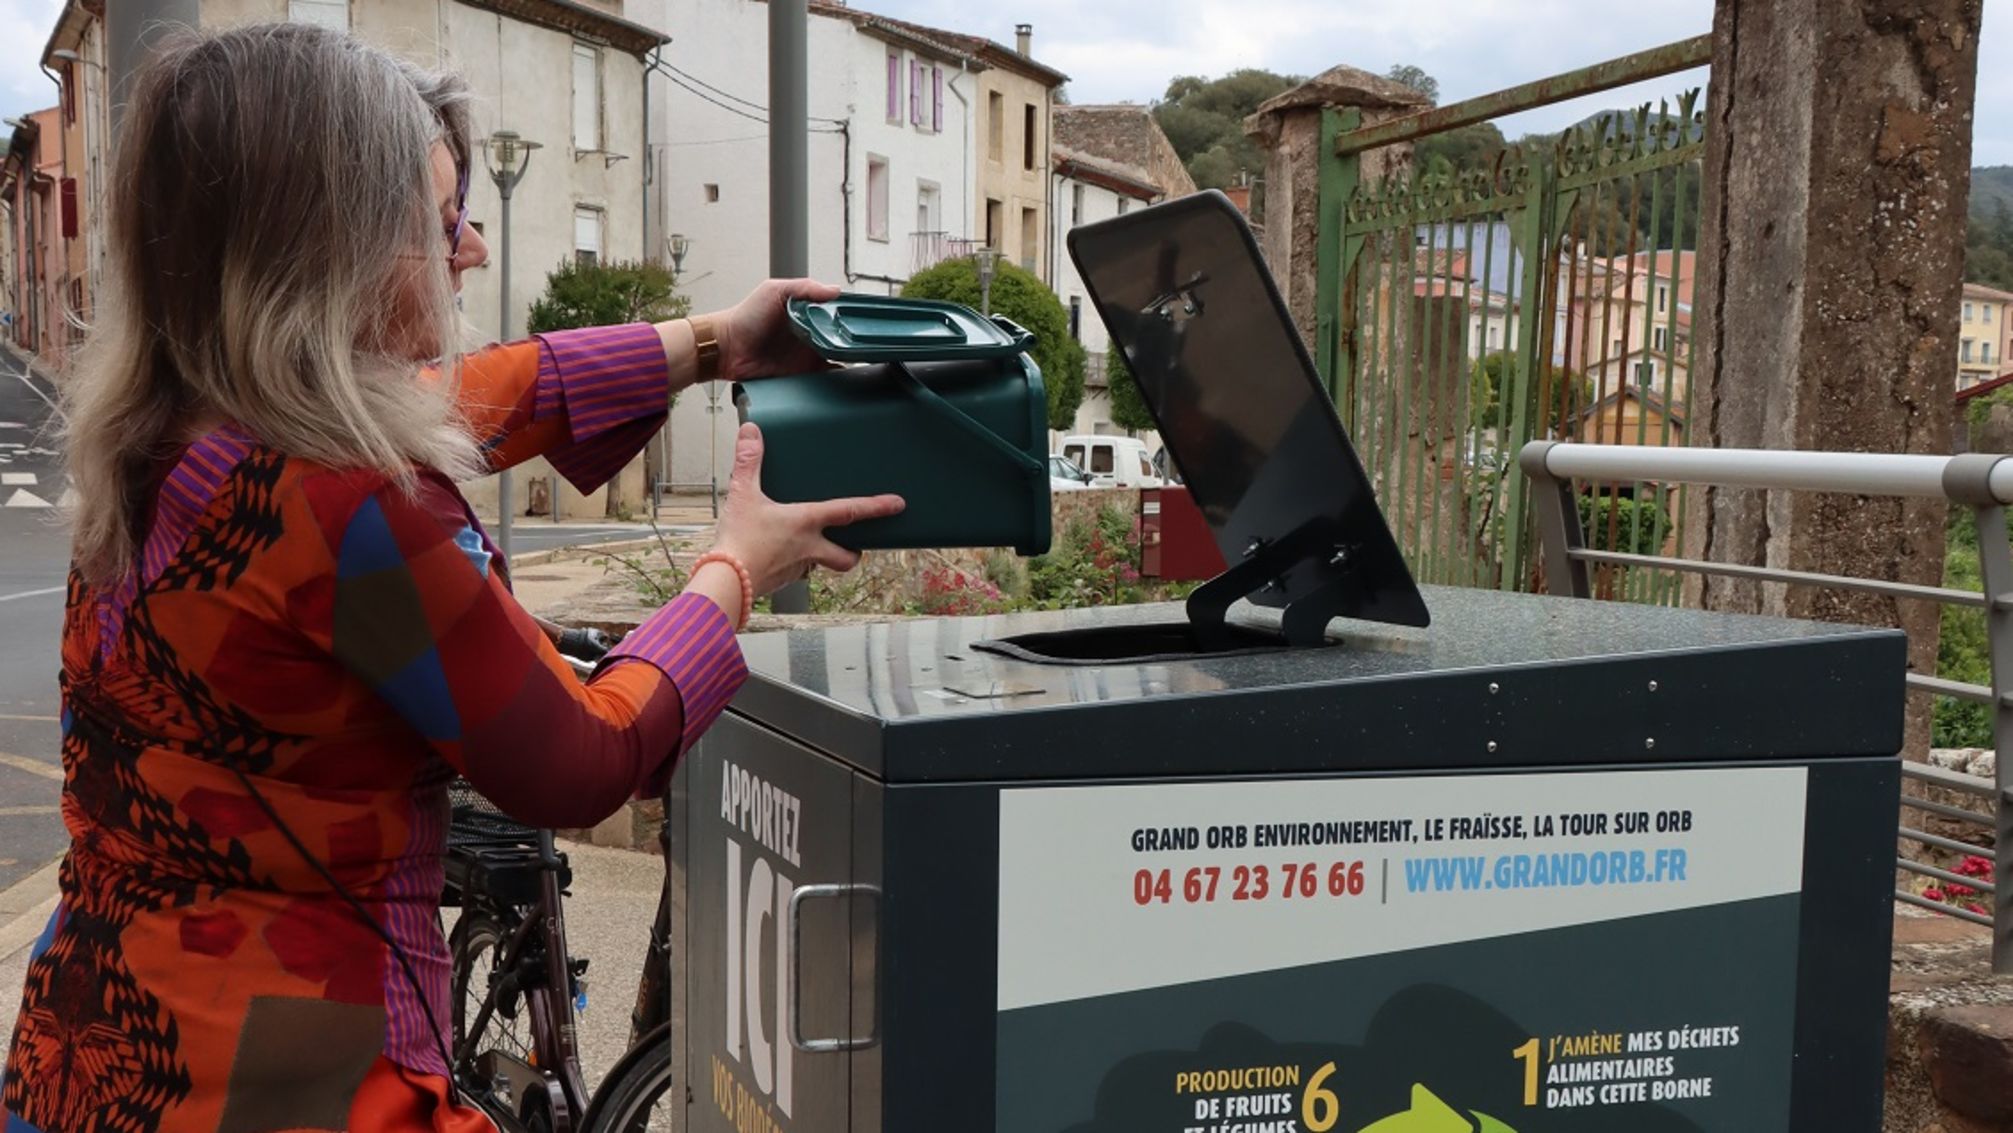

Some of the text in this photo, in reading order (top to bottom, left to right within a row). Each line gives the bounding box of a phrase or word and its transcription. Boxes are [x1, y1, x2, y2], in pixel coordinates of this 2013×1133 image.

[720, 759, 801, 869] APPORTEZ
[1131, 810, 1692, 852] GRAND ORB ENVIRONNEMENT, LE FRAÏSSE, LA TOUR SUR ORB
[1134, 848, 1687, 905] 04 67 23 76 66 WWW.GRANDORB.FR
[725, 837, 793, 1120] ICI
[1628, 1031, 1663, 1053] MES
[1668, 1024, 1740, 1050] DÉCHETS
[711, 1054, 733, 1121] VOS
[1176, 1065, 1299, 1094] PRODUCTION
[1513, 1038, 1540, 1106] 1
[1546, 1056, 1674, 1084] ALIMENTAIRES
[1546, 1077, 1712, 1109] DANS CETTE BORNE
[1195, 1093, 1293, 1120] DE FRUITS
[1302, 1061, 1339, 1132] 6
